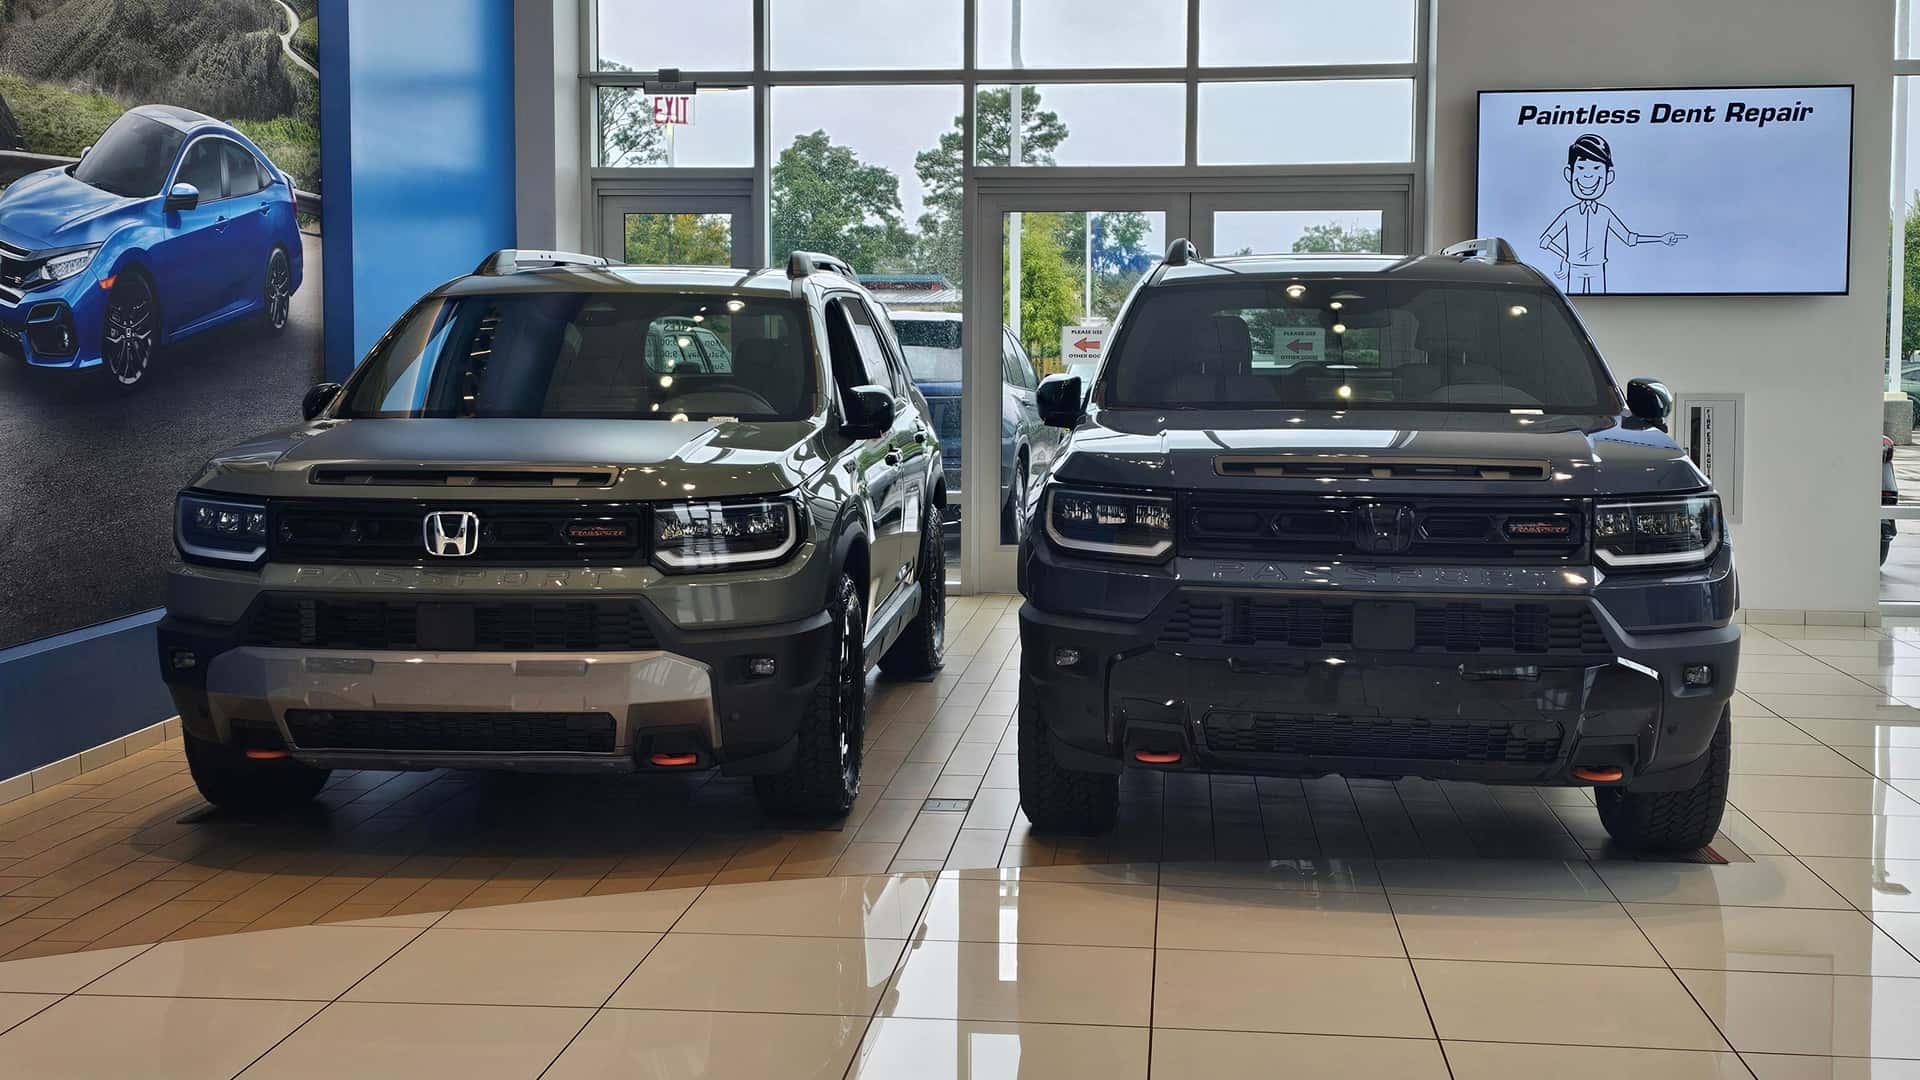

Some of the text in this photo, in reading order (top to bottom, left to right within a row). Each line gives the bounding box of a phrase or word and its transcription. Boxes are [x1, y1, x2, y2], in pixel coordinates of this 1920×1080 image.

[654, 96, 689, 125] EXIT
[1517, 101, 1814, 128] Paintless Dent Repair
[294, 566, 614, 590] PASSPORT
[1209, 560, 1550, 588] PASSPORT
